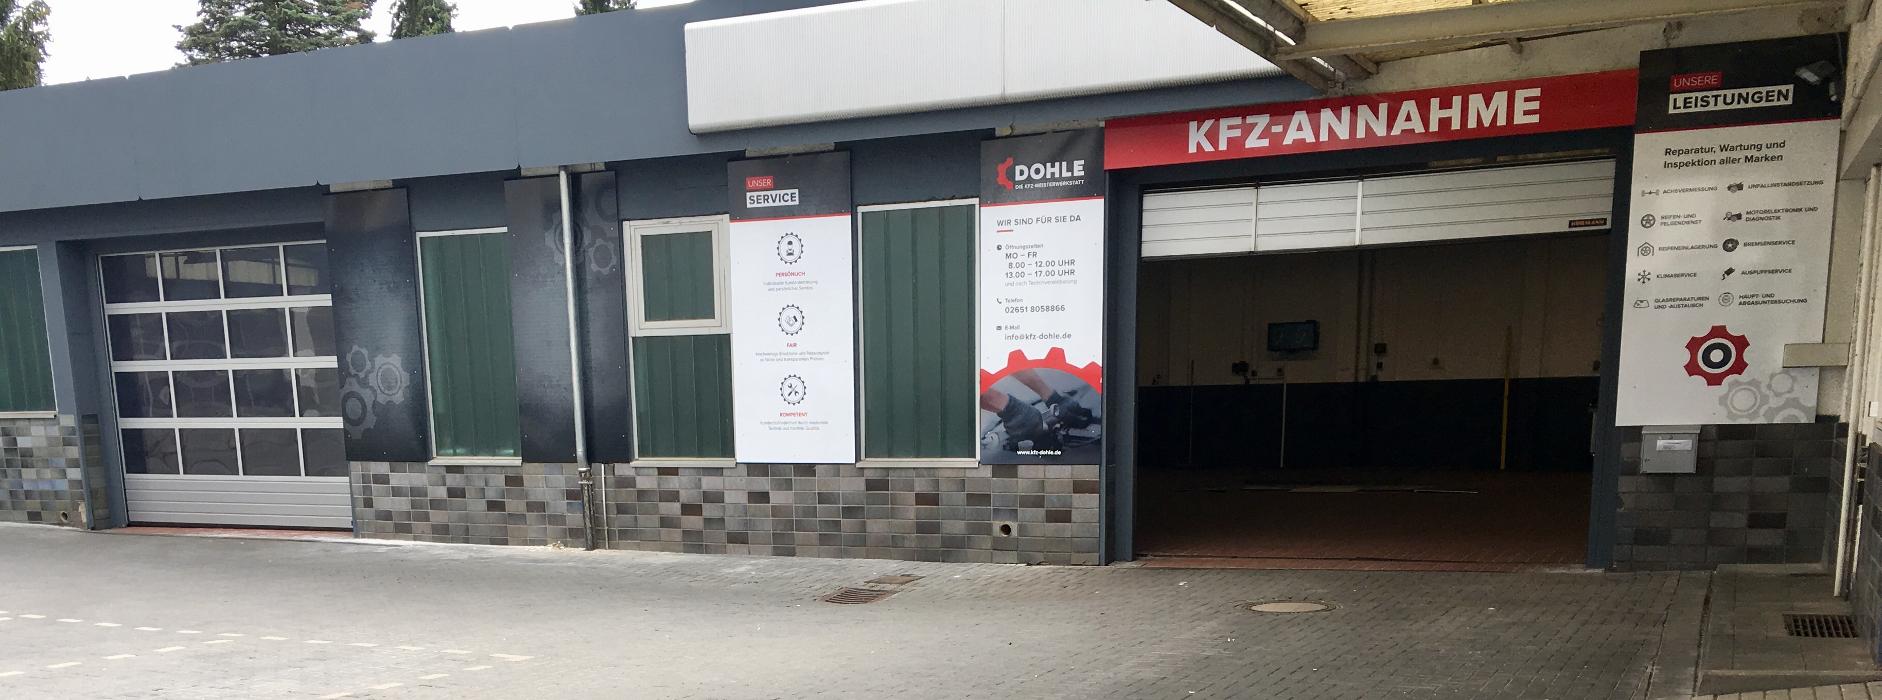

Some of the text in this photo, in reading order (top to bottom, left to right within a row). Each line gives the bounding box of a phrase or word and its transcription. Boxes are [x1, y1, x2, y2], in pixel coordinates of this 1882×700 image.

[1673, 74, 1719, 87] UNSERE
[1672, 88, 1790, 110] LEISTUNGEN
[1188, 87, 1542, 154] KFZ-ANNAHME
[1664, 140, 1786, 158] Reparatur, Wartung und
[1663, 153, 1784, 169] Inspektion aller Marken
[1014, 159, 1085, 181] DOHLE
[747, 178, 772, 188] UNSER
[1748, 179, 1824, 189] UNFALLINSTANDSETZUNG
[1662, 186, 1718, 194] ACHSVERMESSUNG
[748, 192, 797, 205] SERVICE
[1745, 208, 1803, 216] MOTORELEKTRONIK
[996, 214, 1082, 227] WIR SIND FÜR SIE DA
[1660, 219, 1702, 227] FELGENDIENST
[1743, 239, 1796, 247] BREMSENSERVICE
[1005, 252, 1018, 260] MO
[1027, 251, 1037, 259] FR
[1008, 261, 1025, 269] 8.00
[1035, 260, 1055, 268] 12.00
[1057, 259, 1076, 267] UHR
[1005, 271, 1025, 279] 13.00
[1035, 270, 1055, 278] 17.00
[1057, 269, 1076, 277] UHR
[1654, 296, 1709, 304] GLASREPARATUREN
[1738, 298, 1808, 306] ABGASUNTERSUCHUNG
[1030, 304, 1066, 312] 8058866
[1004, 332, 1072, 341] info@kfz-dohle.de
